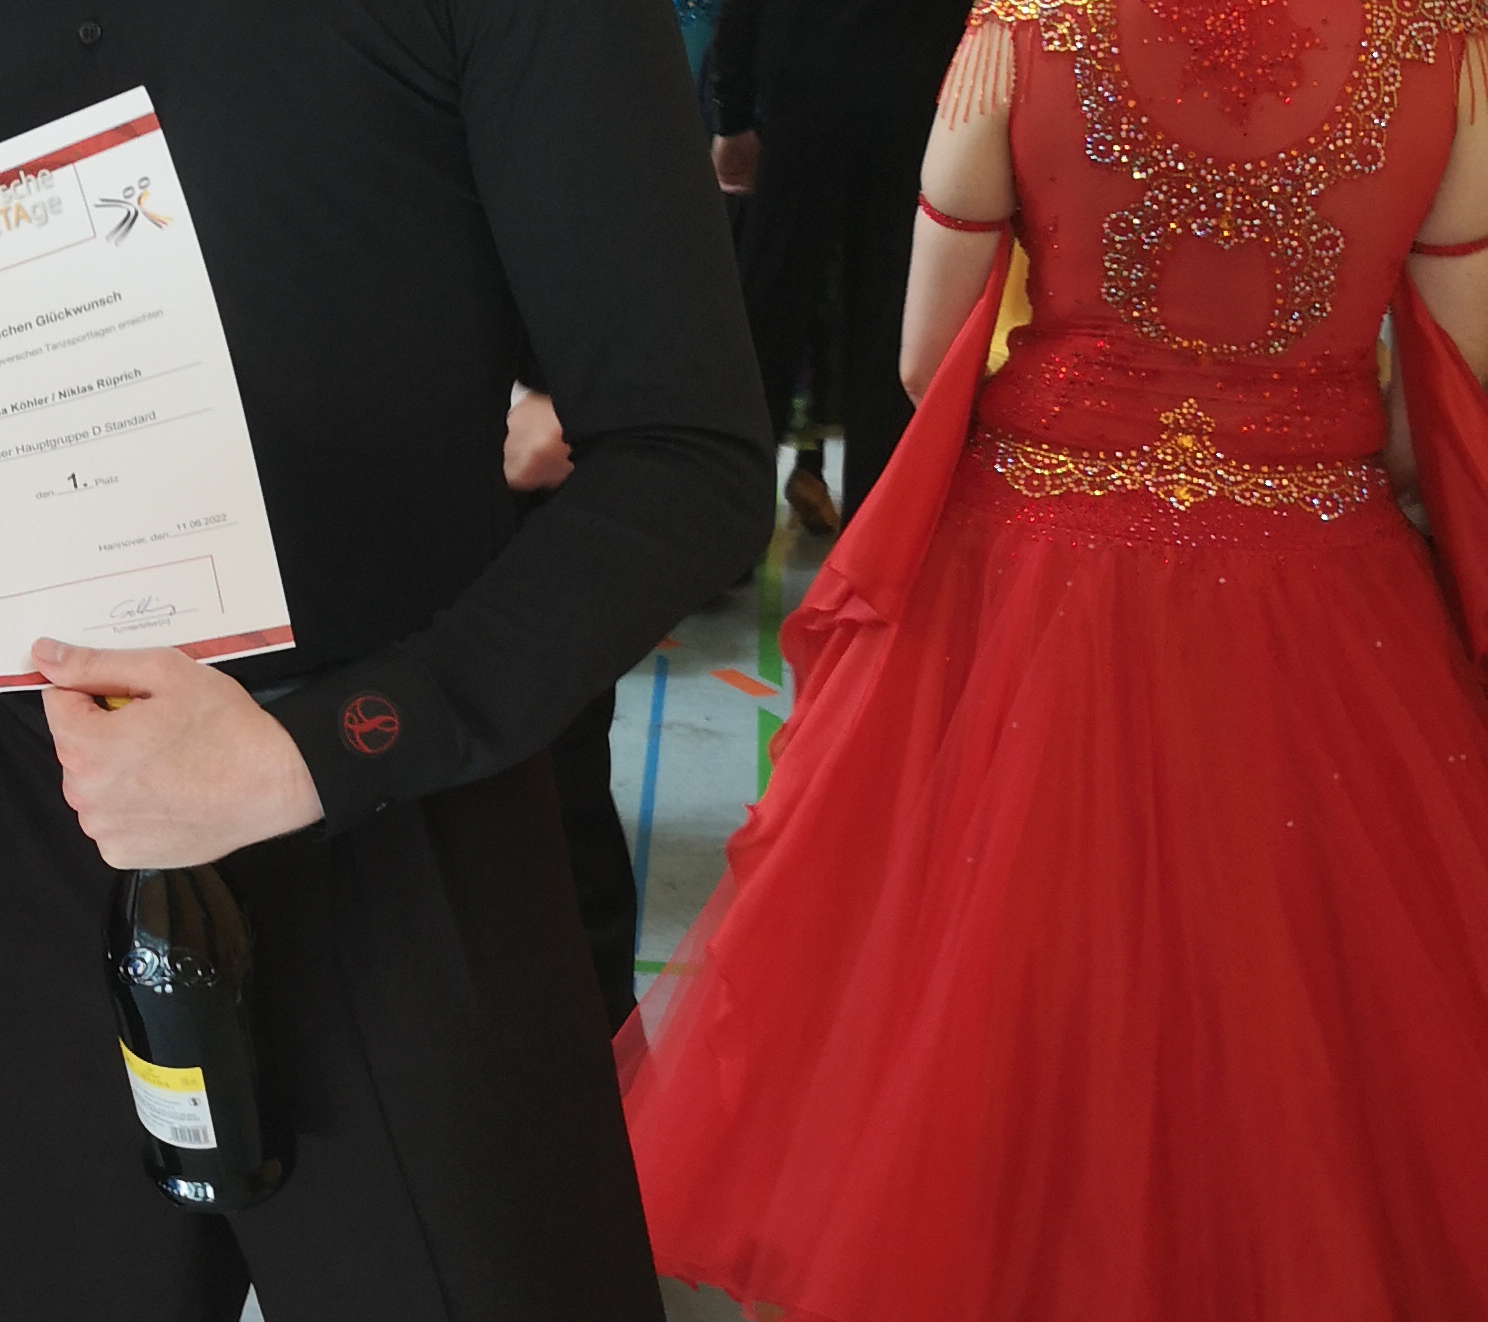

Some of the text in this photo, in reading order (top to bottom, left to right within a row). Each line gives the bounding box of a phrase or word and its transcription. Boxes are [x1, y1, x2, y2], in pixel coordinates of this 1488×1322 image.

[35, 290, 123, 327] Glückwunsch
[10, 394, 49, 413] Köhler
[58, 382, 94, 400] Niklas
[96, 368, 143, 390] Rüprich
[15, 429, 90, 455] Hauptgruppe
[92, 425, 102, 437] D
[104, 410, 157, 433] Standard
[35, 472, 119, 500] den 1. Platz
[150, 531, 169, 542] den
